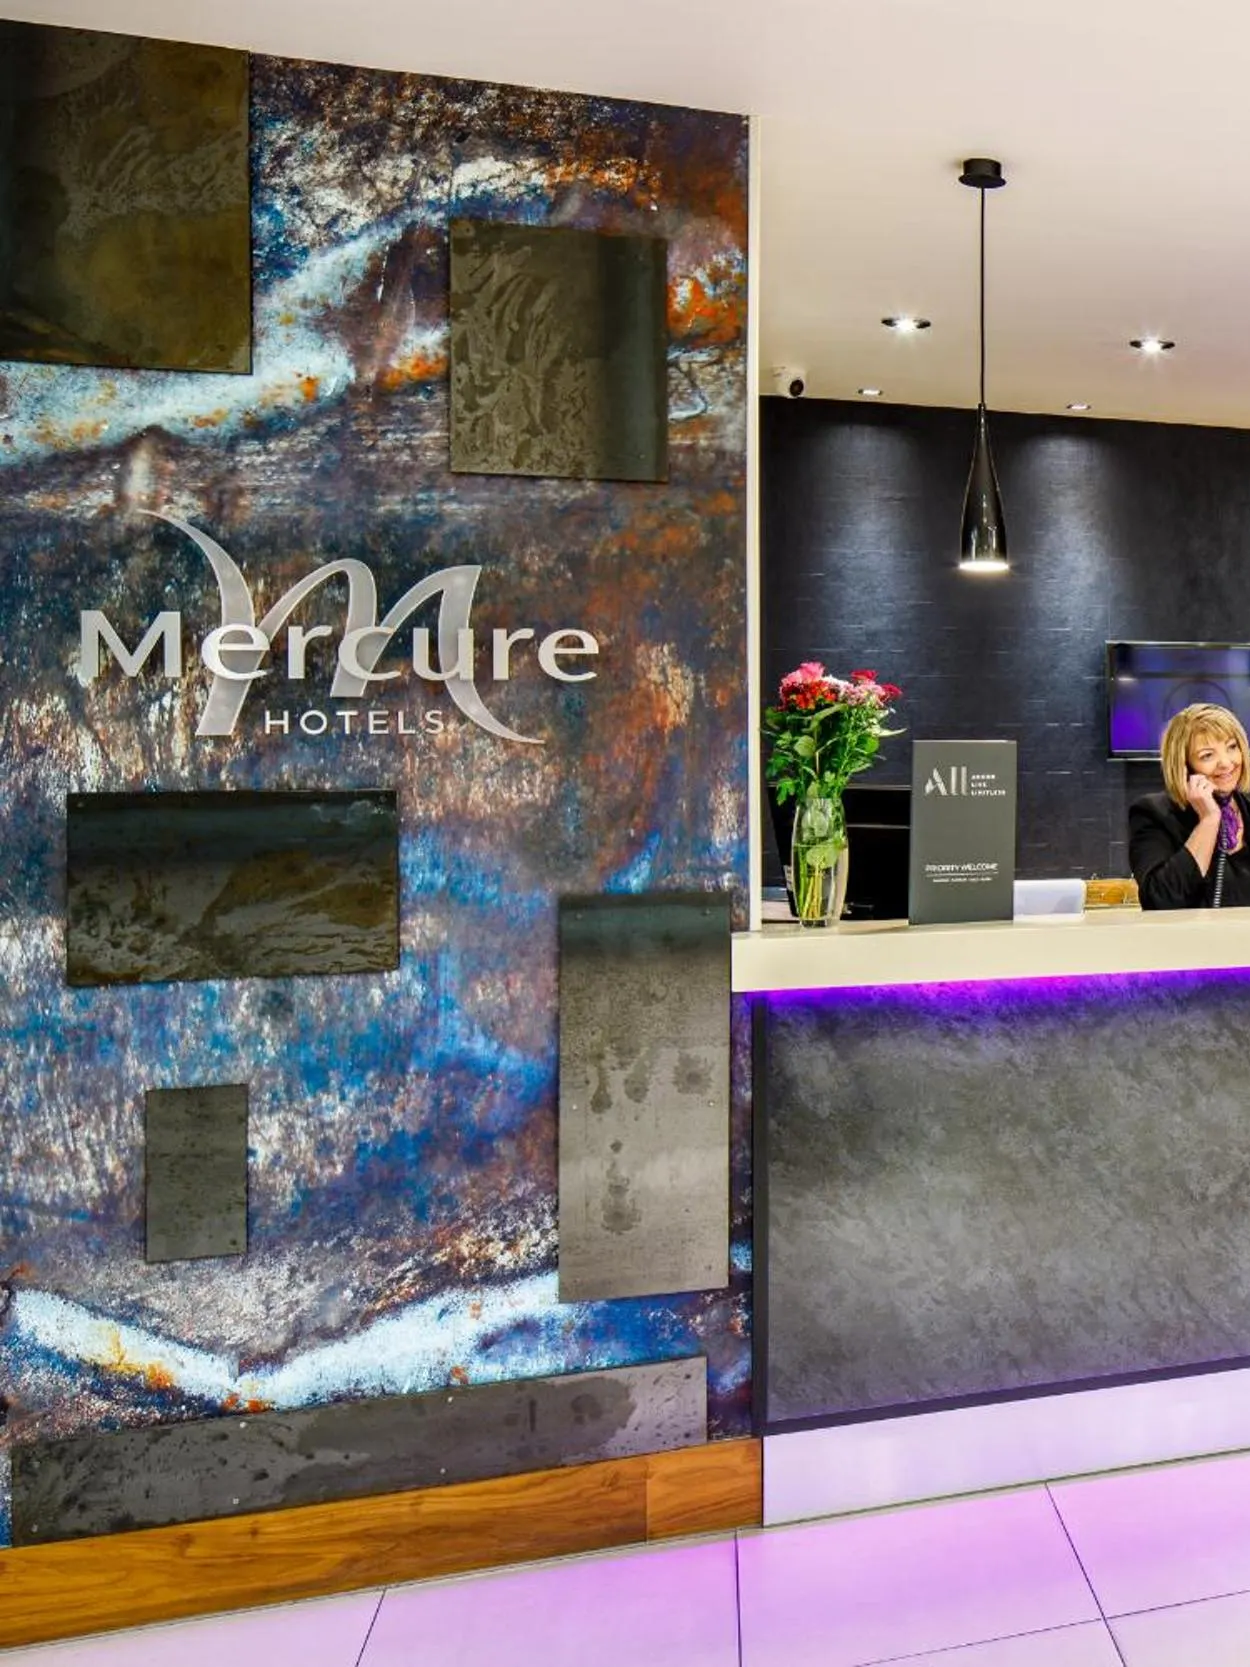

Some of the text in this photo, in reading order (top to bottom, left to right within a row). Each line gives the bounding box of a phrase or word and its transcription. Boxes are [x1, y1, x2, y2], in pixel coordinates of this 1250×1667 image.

[79, 610, 600, 682] Mercure
[264, 709, 446, 736] HOTELS
[961, 862, 999, 871] WELCOME
